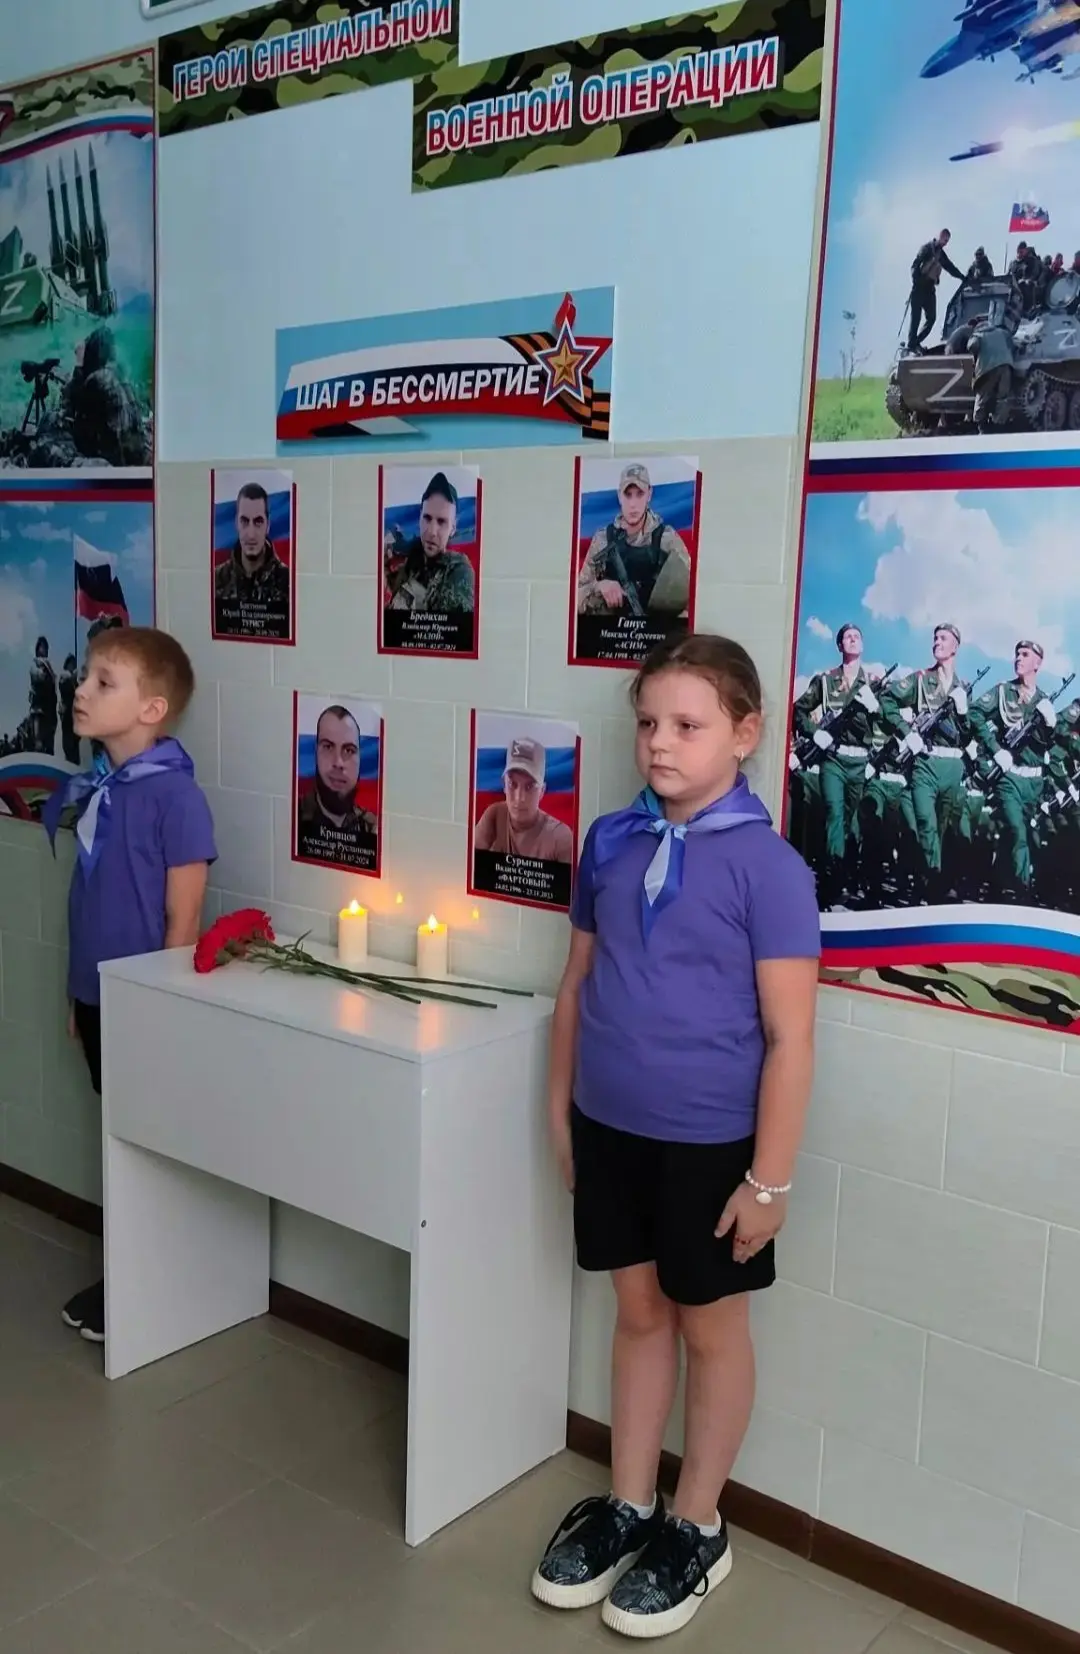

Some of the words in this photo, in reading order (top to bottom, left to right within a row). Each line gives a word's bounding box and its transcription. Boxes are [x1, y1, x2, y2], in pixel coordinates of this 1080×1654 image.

[173, 46, 248, 102] ГЕРОИ
[427, 71, 574, 155] ВОЕННОЙ
[580, 36, 779, 125] ОПЕРАЦИИ
[295, 382, 345, 411] ШАГ
[349, 380, 365, 407] В
[371, 364, 543, 406] БЕССМЕРТИЕ
[410, 611, 448, 622] Бредихин
[618, 616, 647, 631] Ганус
[600, 629, 628, 639] Максим
[629, 631, 666, 641] Сергеевич
[320, 825, 357, 842] Кривцов
[505, 854, 543, 869] Сурыгин
[518, 867, 555, 880] Сергеевич
